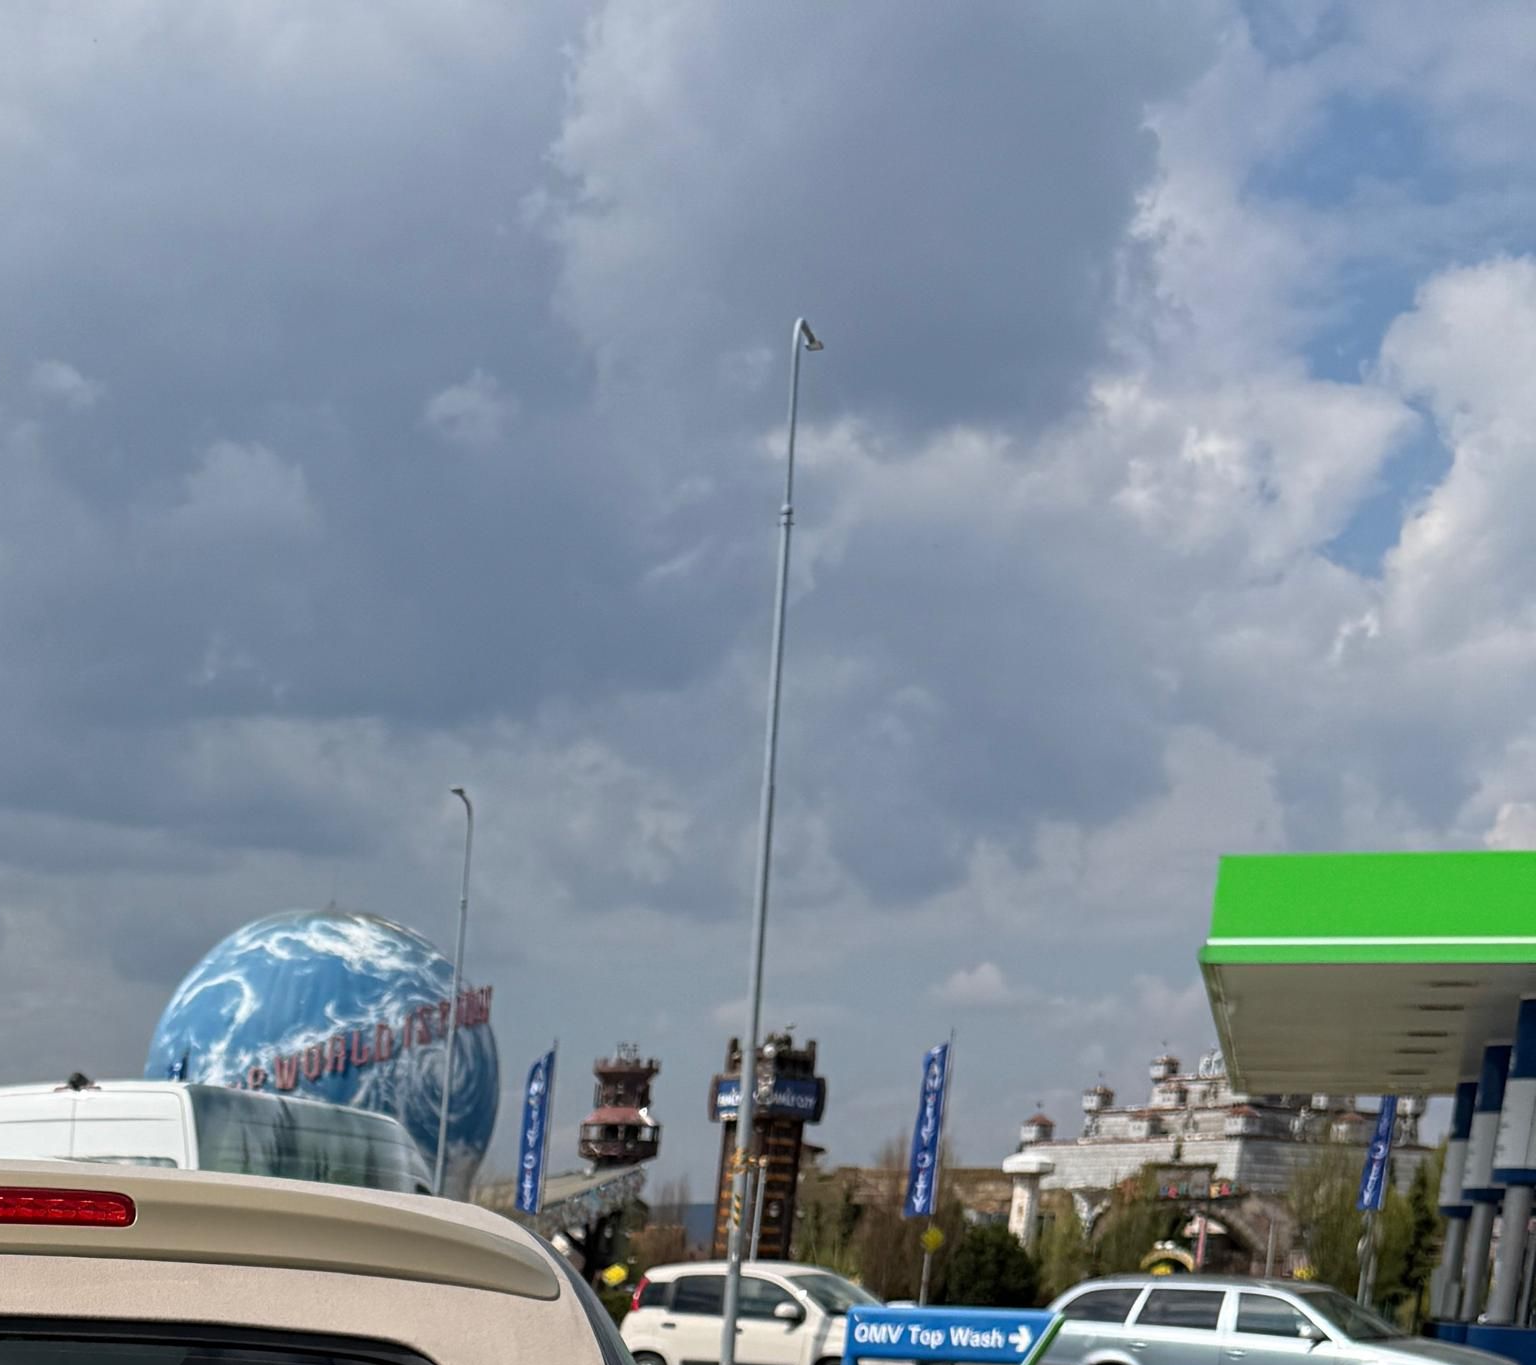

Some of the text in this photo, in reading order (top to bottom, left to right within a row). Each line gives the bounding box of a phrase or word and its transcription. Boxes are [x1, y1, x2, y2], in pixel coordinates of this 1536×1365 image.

[854, 1322, 1006, 1350] OMV Top Wash
